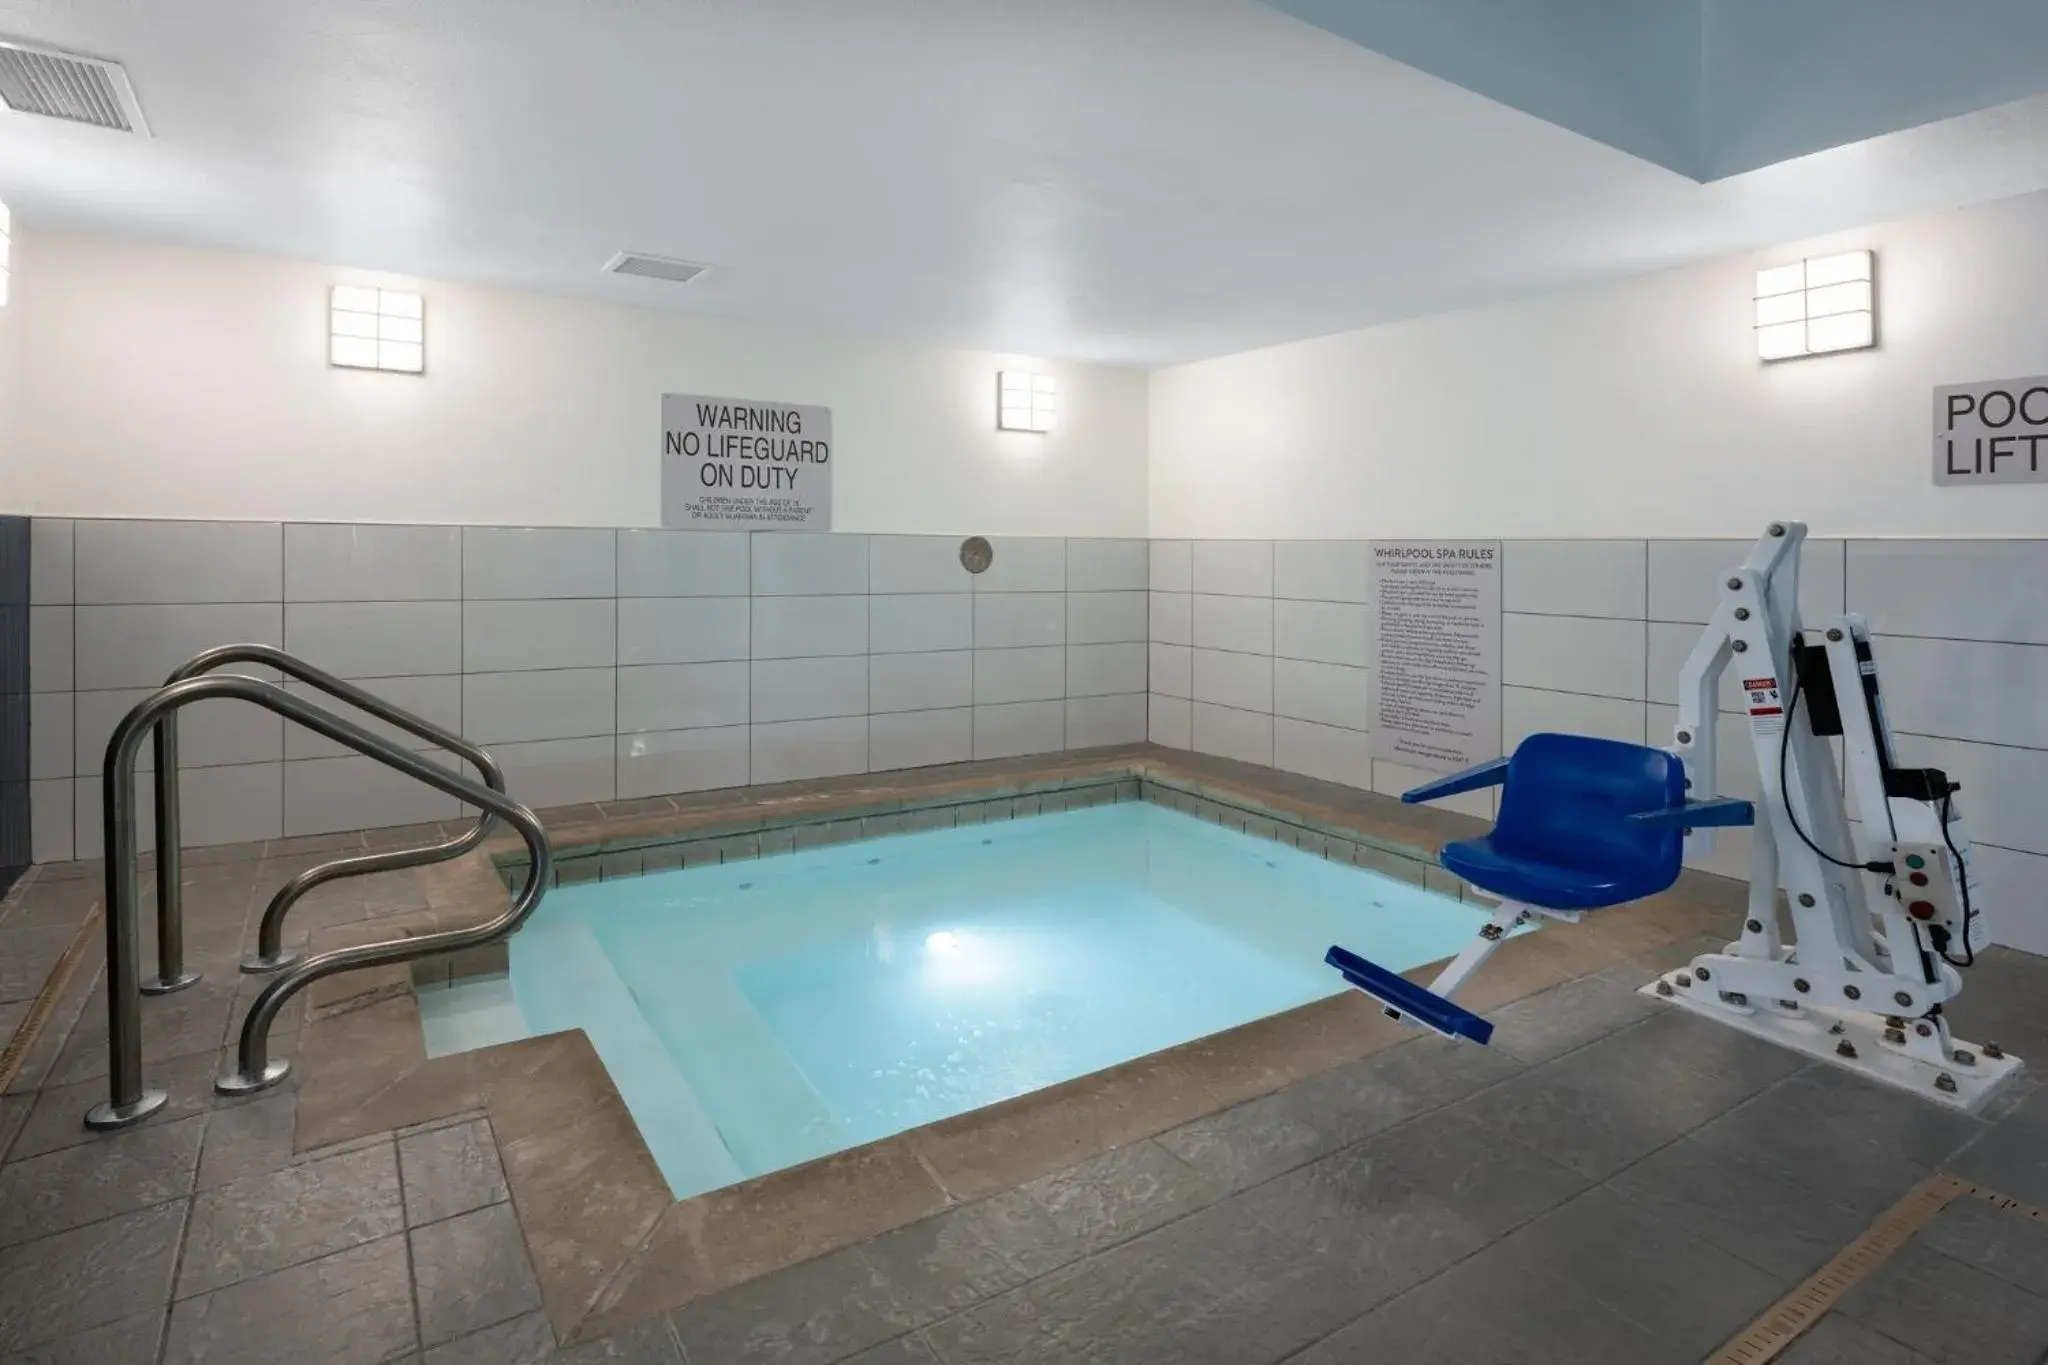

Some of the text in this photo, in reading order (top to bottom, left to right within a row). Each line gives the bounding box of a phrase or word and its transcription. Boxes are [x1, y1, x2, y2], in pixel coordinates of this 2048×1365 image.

[696, 403, 801, 435] WARNING
[666, 431, 829, 464] NO LIFEGUARD
[1947, 433, 2048, 475] LIFT
[700, 462, 799, 490] ON DUTY
[1374, 548, 1494, 560] WHIRLPOOL SPA RULES
